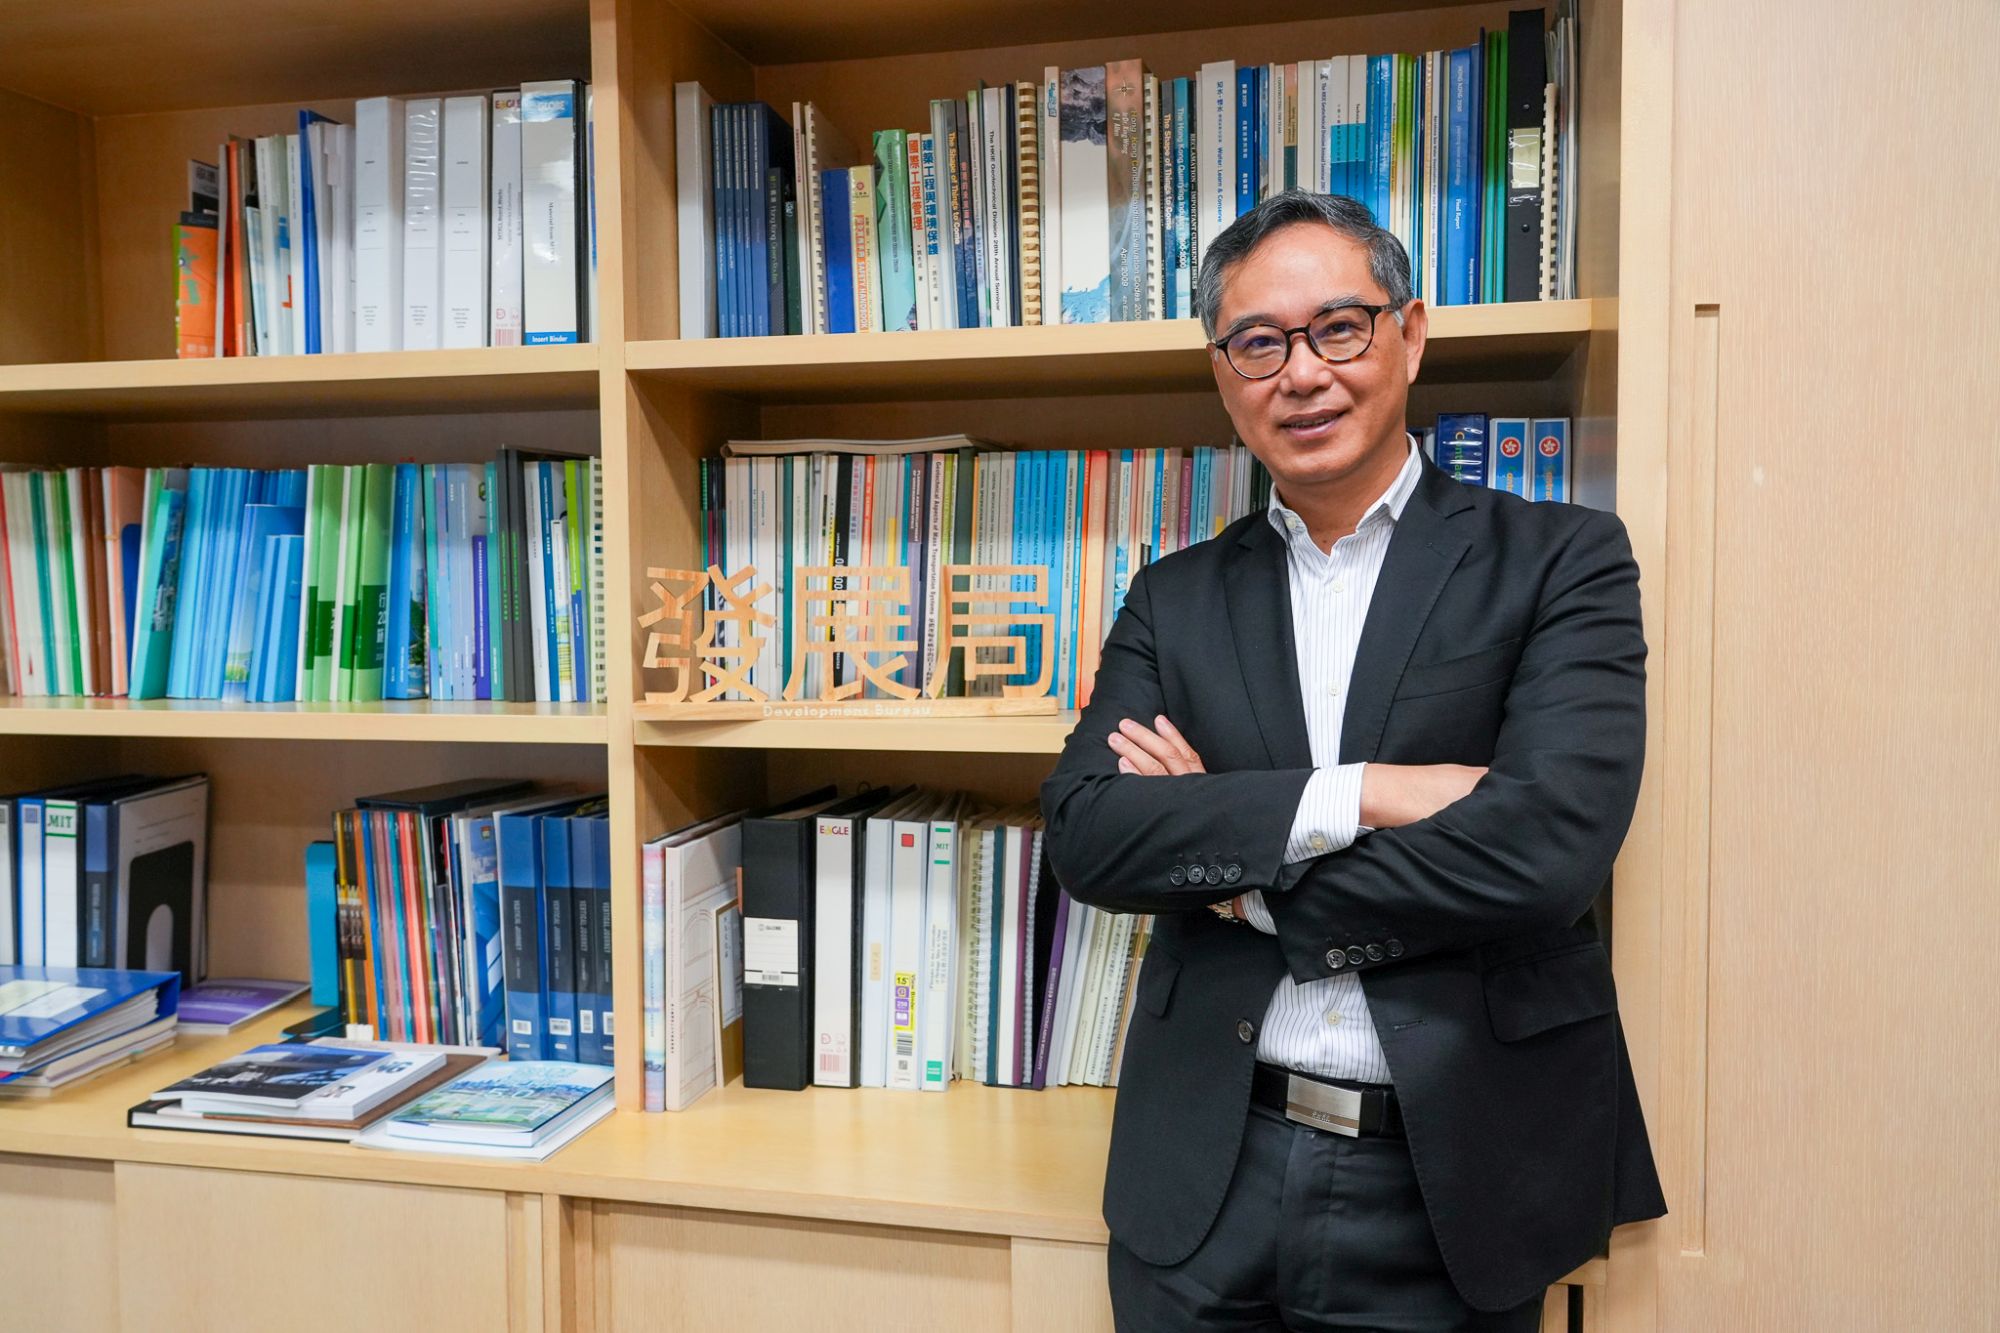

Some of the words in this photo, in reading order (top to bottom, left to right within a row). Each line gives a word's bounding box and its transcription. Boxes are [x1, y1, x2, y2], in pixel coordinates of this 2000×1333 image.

[1131, 111, 1139, 132] Hong
[1163, 114, 1171, 127] The
[1163, 130, 1171, 156] Shape
[1176, 122, 1184, 142] Hong
[1131, 135, 1139, 158] Kong
[1176, 143, 1185, 163] Kong
[1165, 157, 1172, 167] of
[951, 174, 958, 184] of
[990, 164, 998, 210] Geotechnical
[1164, 168, 1172, 194] Things
[1176, 165, 1186, 200] Quarrying
[951, 185, 959, 210] Things
[1166, 196, 1172, 206] to
[953, 211, 959, 219] to
[1132, 192, 1140, 232] Condition
[1454, 211, 1462, 230] Report
[1120, 247, 1128, 265] April
[1133, 233, 1141, 274] Evaluation
[934, 461, 942, 500] Geotechnical
[932, 500, 940, 524] Aspects
[930, 548, 938, 590] Transportation
[928, 591, 936, 615] Systems
[637, 563, 1055, 703] 發展局
[762, 705, 870, 718] Development
[874, 704, 932, 716] Bureau
[48, 815, 73, 828] MIT
[936, 842, 950, 850] MIT
